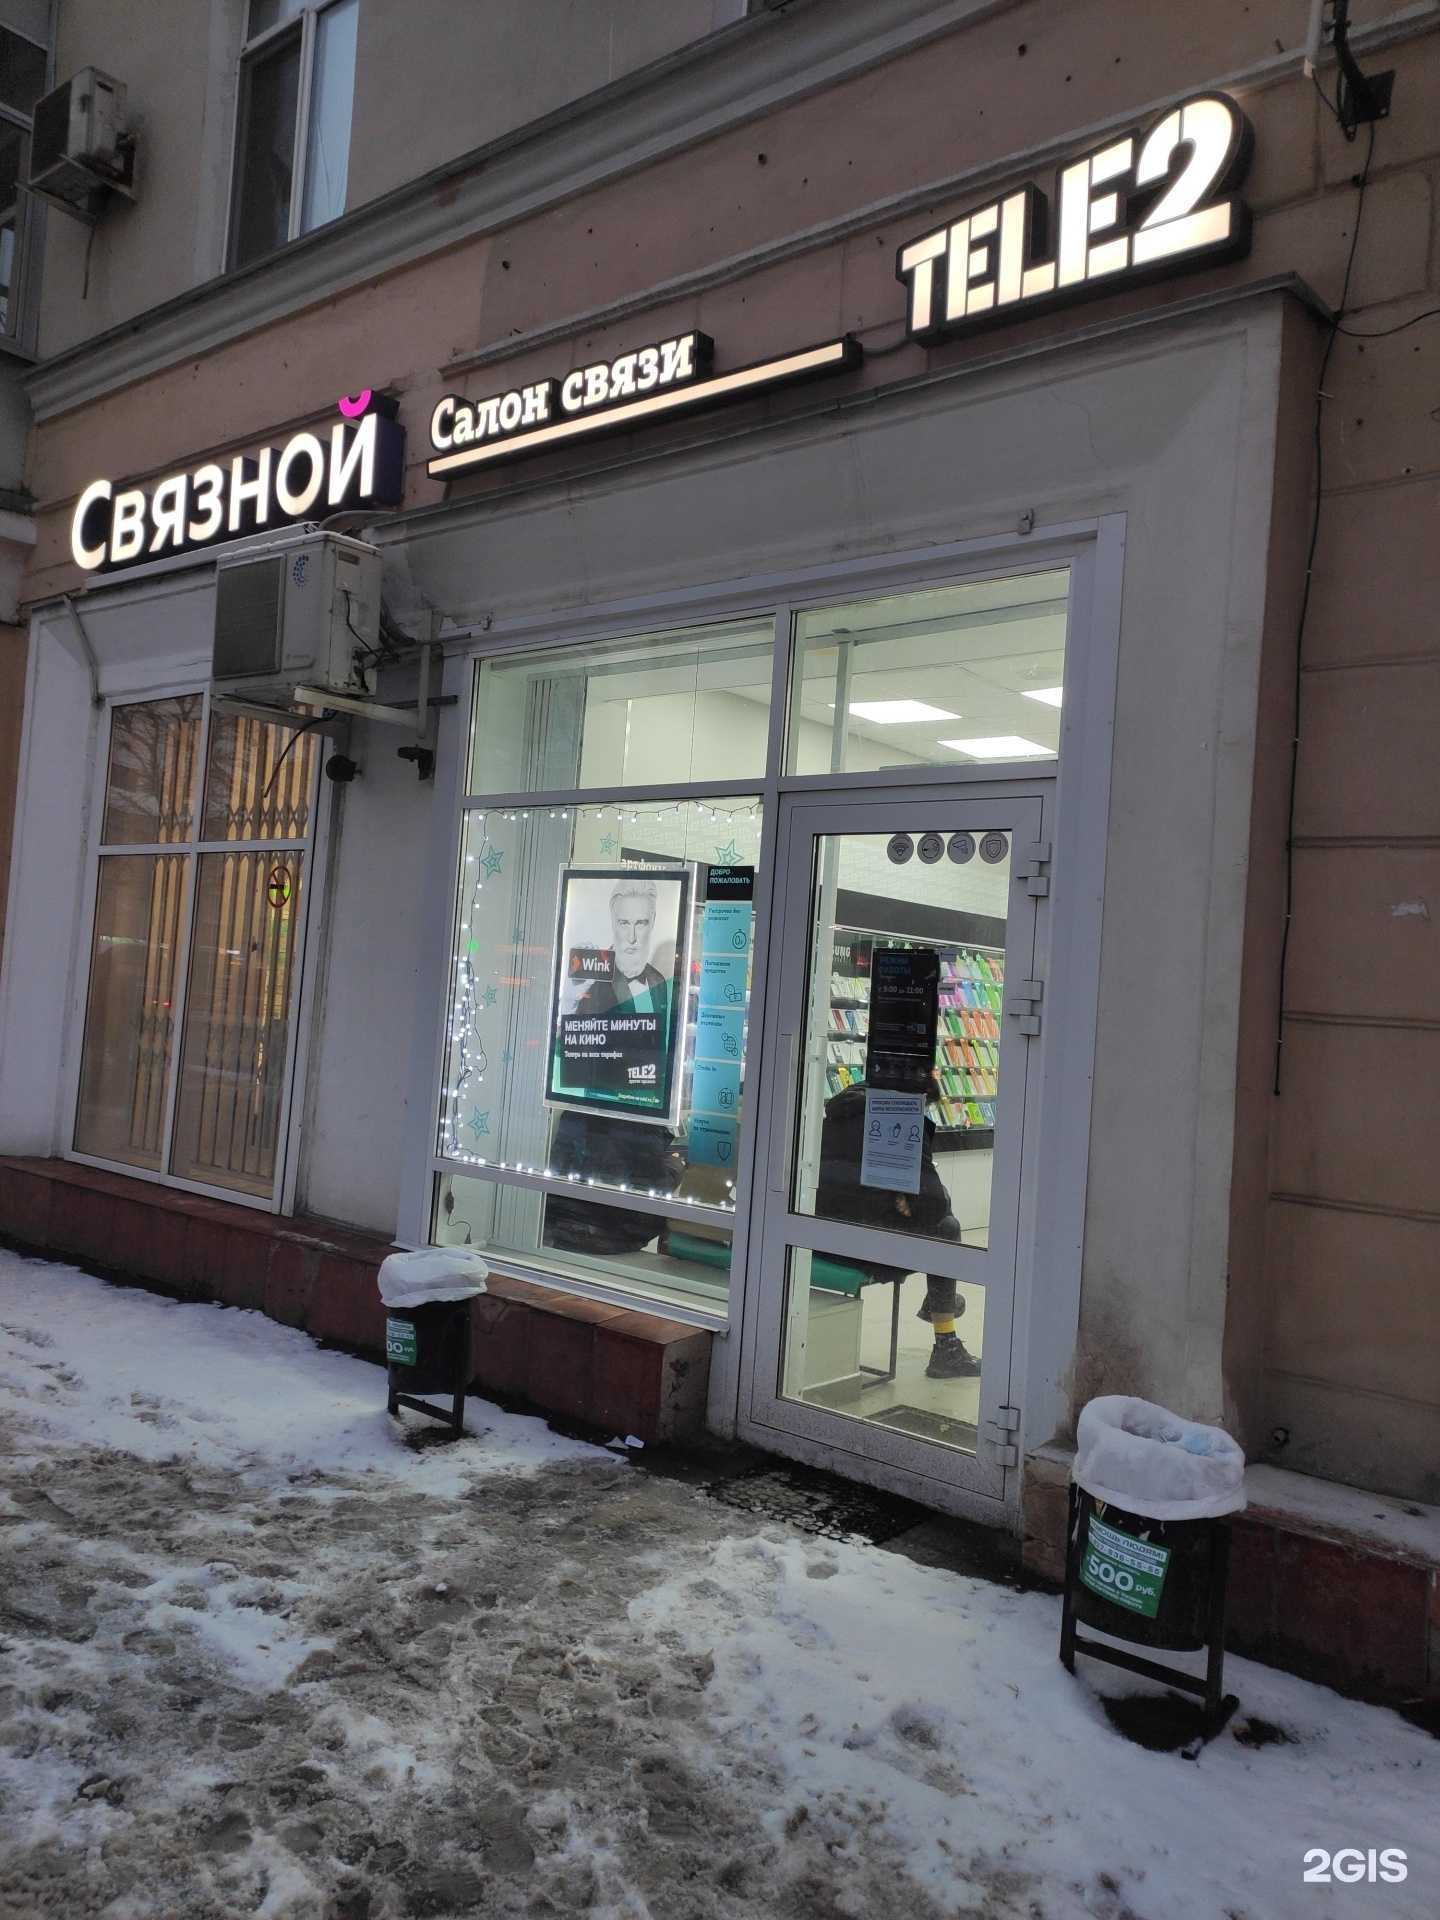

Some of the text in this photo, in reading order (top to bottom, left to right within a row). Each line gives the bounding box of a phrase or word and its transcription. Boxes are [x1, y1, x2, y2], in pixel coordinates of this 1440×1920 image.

[900, 98, 1232, 331] TELE2
[431, 333, 694, 450] Салон связи
[710, 868, 731, 876] ДОБРО
[582, 957, 611, 973] Wink
[564, 1018, 656, 1032] МЕНЯЙТЕ МИНУТЫ
[564, 1033, 606, 1045] НА КИНО
[628, 1064, 656, 1079] TELE2
[1088, 1555, 1134, 1592] 500
